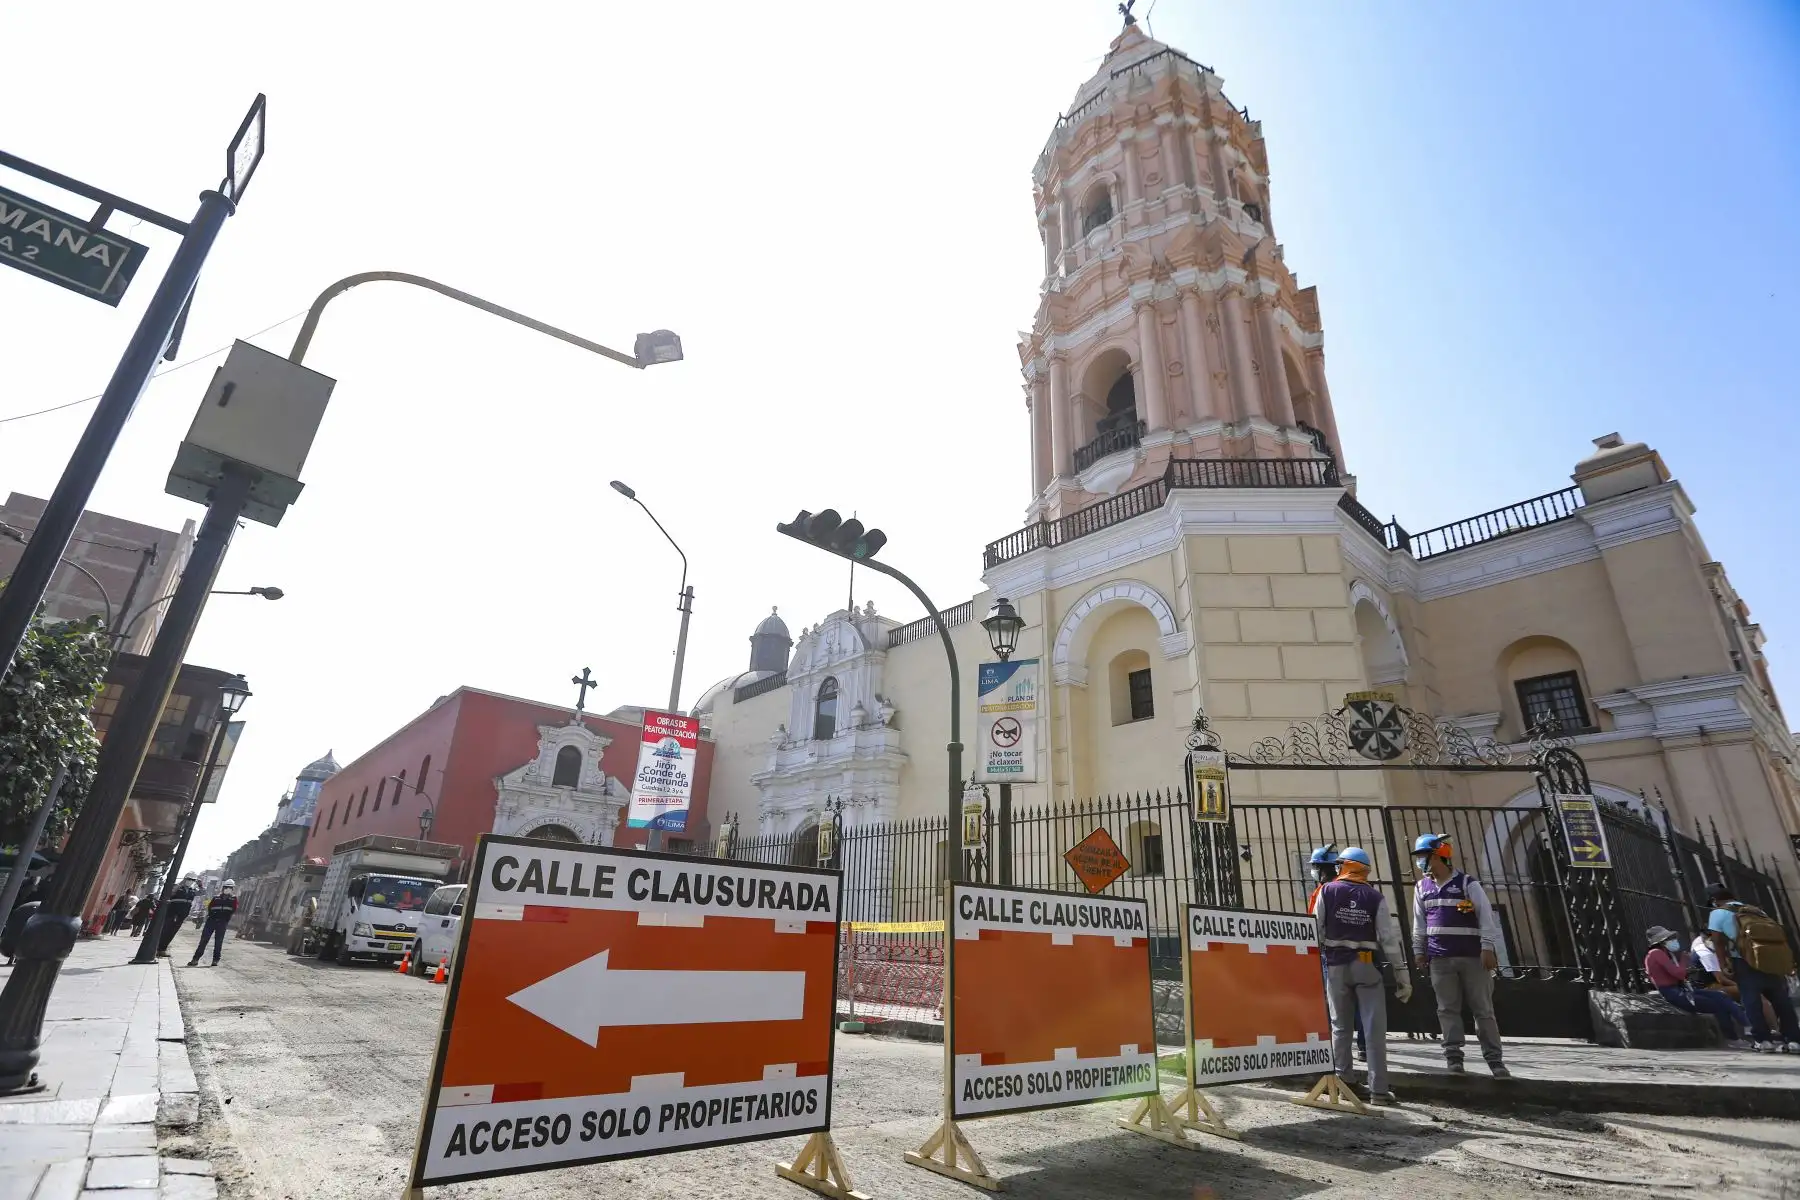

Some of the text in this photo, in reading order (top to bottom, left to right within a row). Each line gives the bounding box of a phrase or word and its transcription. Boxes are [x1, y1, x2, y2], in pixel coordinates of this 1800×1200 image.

[21, 245, 39, 260] 2
[656, 716, 688, 729] OBRAS DE
[644, 724, 697, 739] PEATONALIZACIÓN
[990, 750, 1002, 759] ¡No
[996, 757, 1023, 766] claxon!
[655, 760, 677, 770] Jirón
[638, 773, 689, 787] Superunda
[643, 766, 687, 780] Conde de
[492, 855, 831, 913] CALLE CLAUSURADA
[960, 895, 1144, 931] CALLE CLAUSURADA
[1193, 915, 1316, 941] CALLE CLAUSURADA
[1201, 1048, 1330, 1075] ACCESO SOLO PROPIETARIOS
[962, 1063, 1151, 1101] ACCESO SOLO PROPIETARIOS
[444, 1088, 818, 1158] ACCESO SOLO PROPIETARIOS
